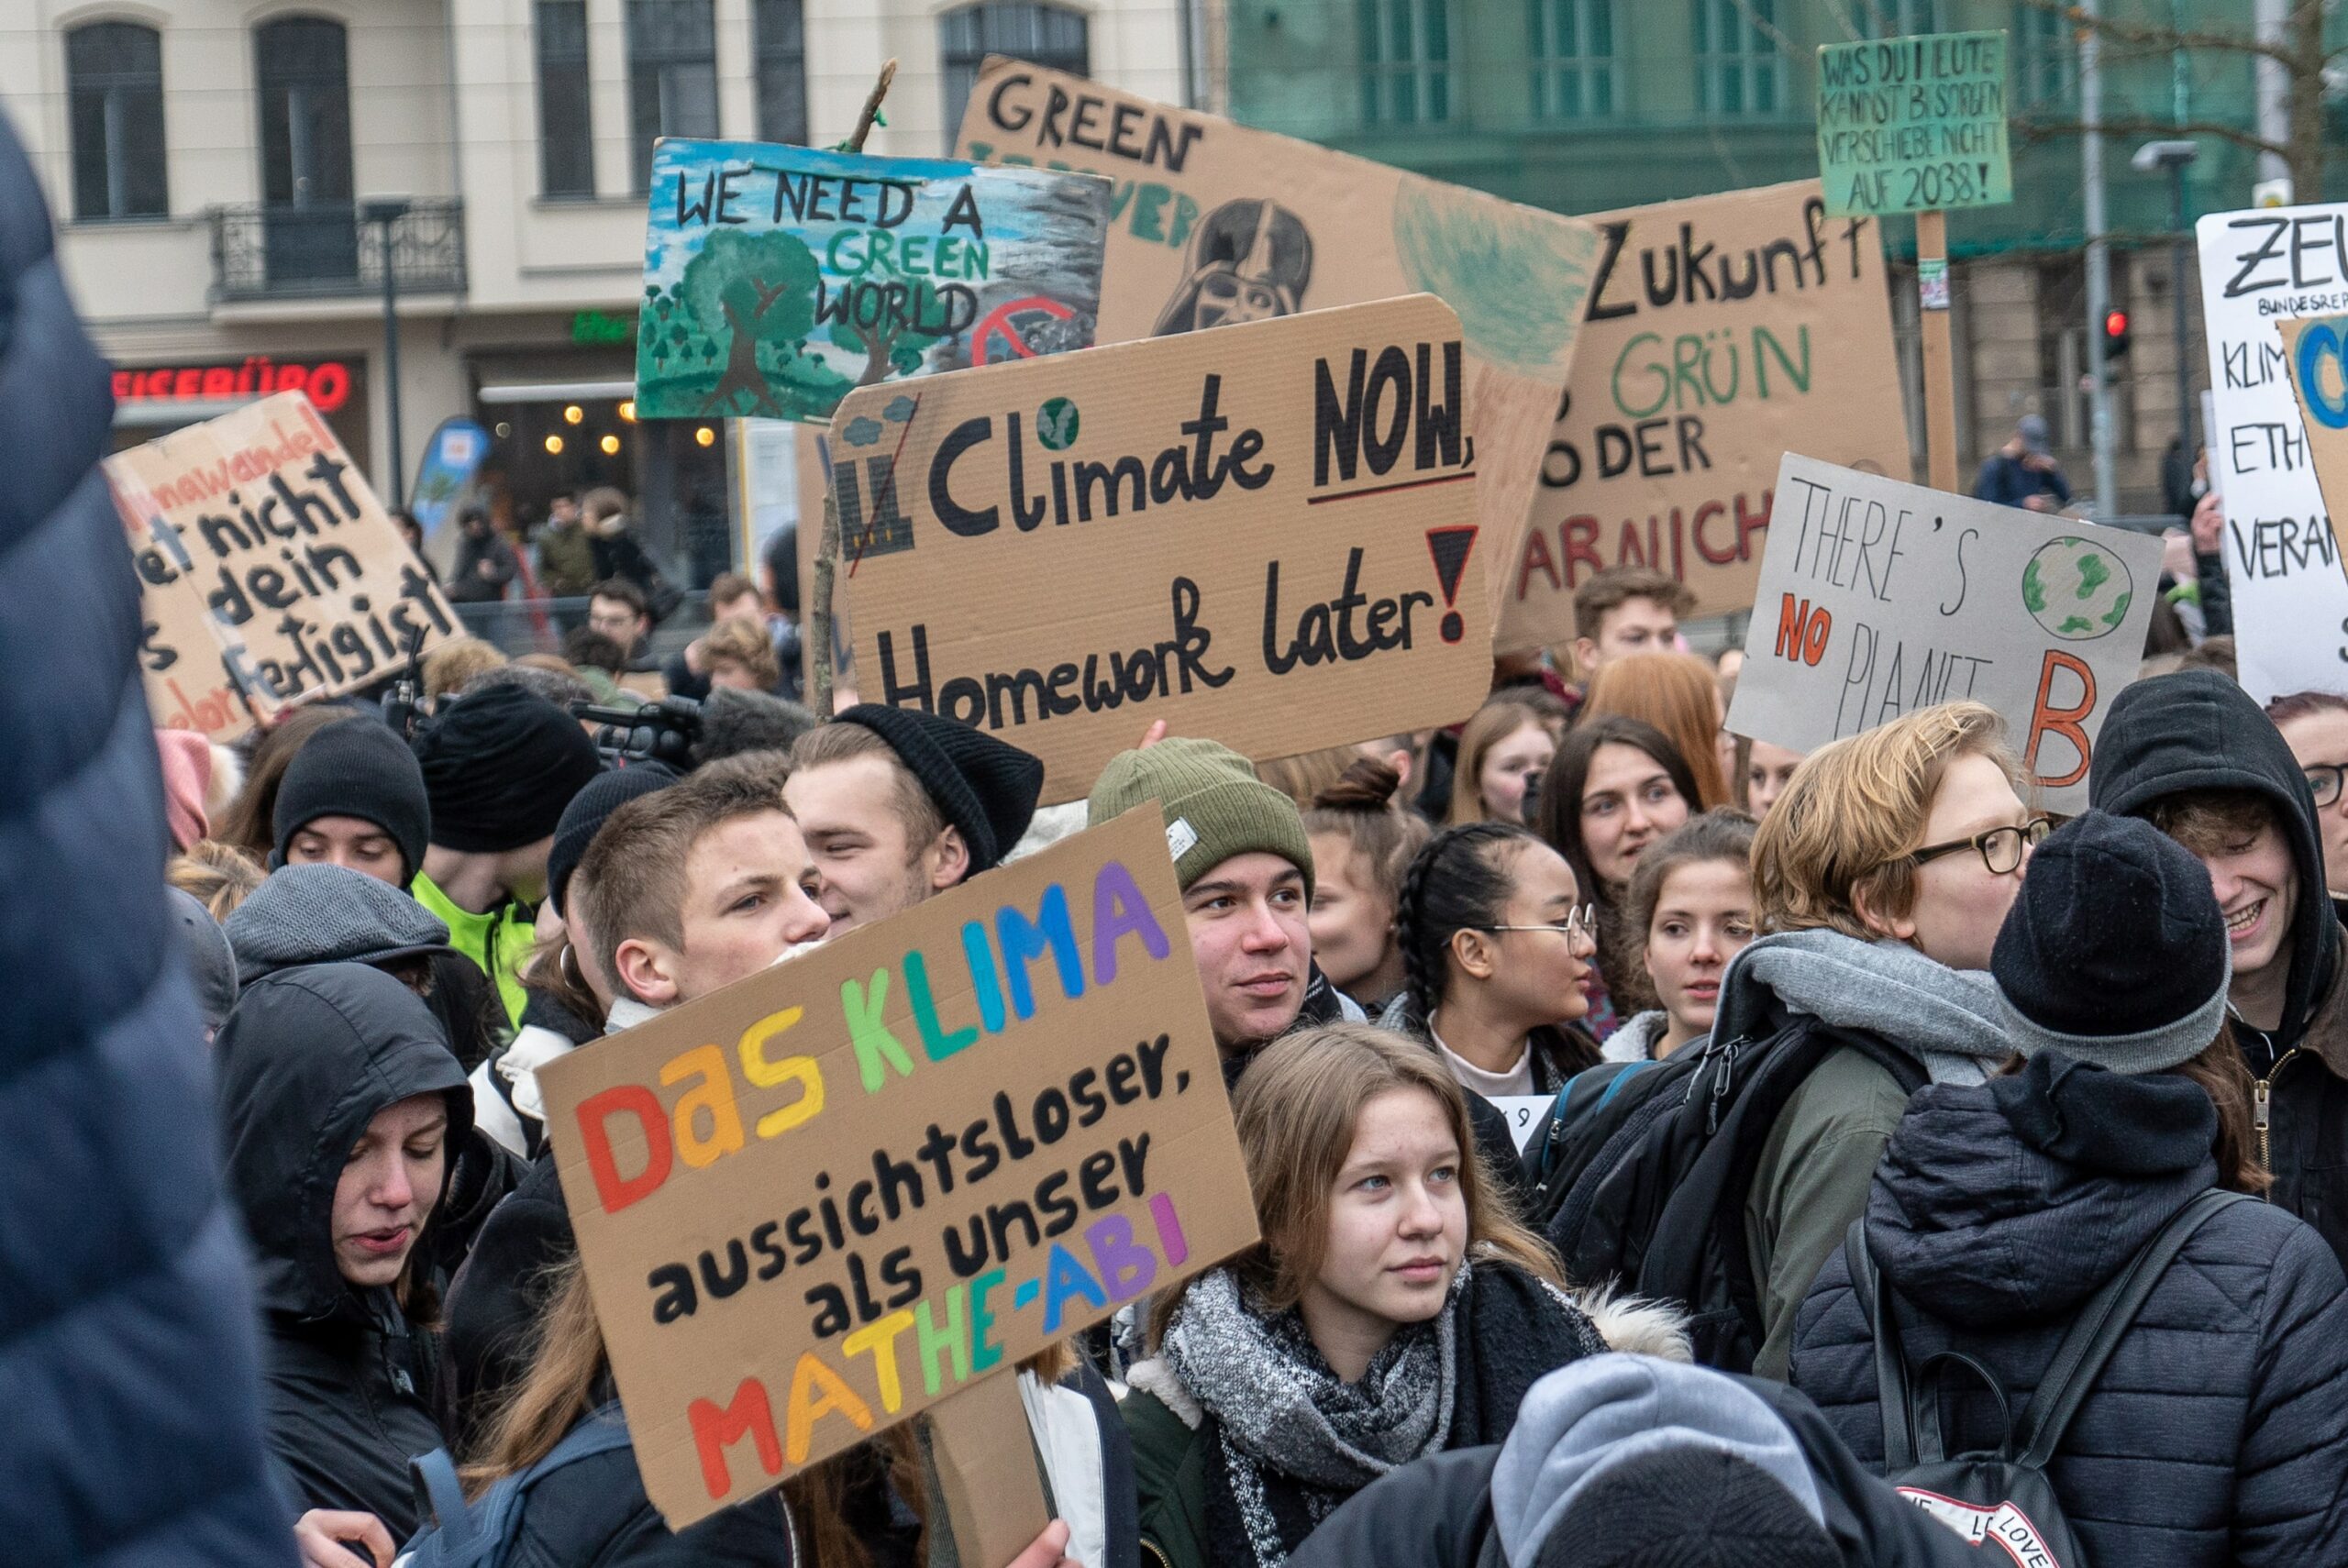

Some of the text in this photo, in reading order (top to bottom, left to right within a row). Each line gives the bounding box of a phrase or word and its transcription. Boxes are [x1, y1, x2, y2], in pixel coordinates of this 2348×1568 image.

[1822, 47, 1870, 86] WAS
[1879, 43, 1908, 82] DU
[988, 73, 1203, 172] GREEN
[1822, 121, 2000, 166] VERSCHIEBE NICHT
[677, 163, 753, 226] WE
[773, 171, 914, 228] NEED
[942, 183, 983, 239] A
[1846, 168, 1894, 210] AUF
[827, 228, 990, 281] GREEN
[2223, 215, 2348, 298] ZE
[815, 279, 979, 337] WORLD
[1611, 324, 1811, 419] GRÜN
[928, 340, 1476, 536] Climate NOW,
[199, 451, 360, 558] nicht
[208, 542, 363, 626] dein
[877, 575, 1235, 732] Homework
[1775, 592, 1833, 668] NO
[2023, 647, 2098, 789] B
[840, 860, 1171, 1095] KLIMA
[647, 1032, 1191, 1325] aussichtsloser,
[803, 1132, 1150, 1340] als unser
[687, 1191, 1188, 1501] MATHE-ABI
[1999, 1516, 2050, 1568] LOVE
